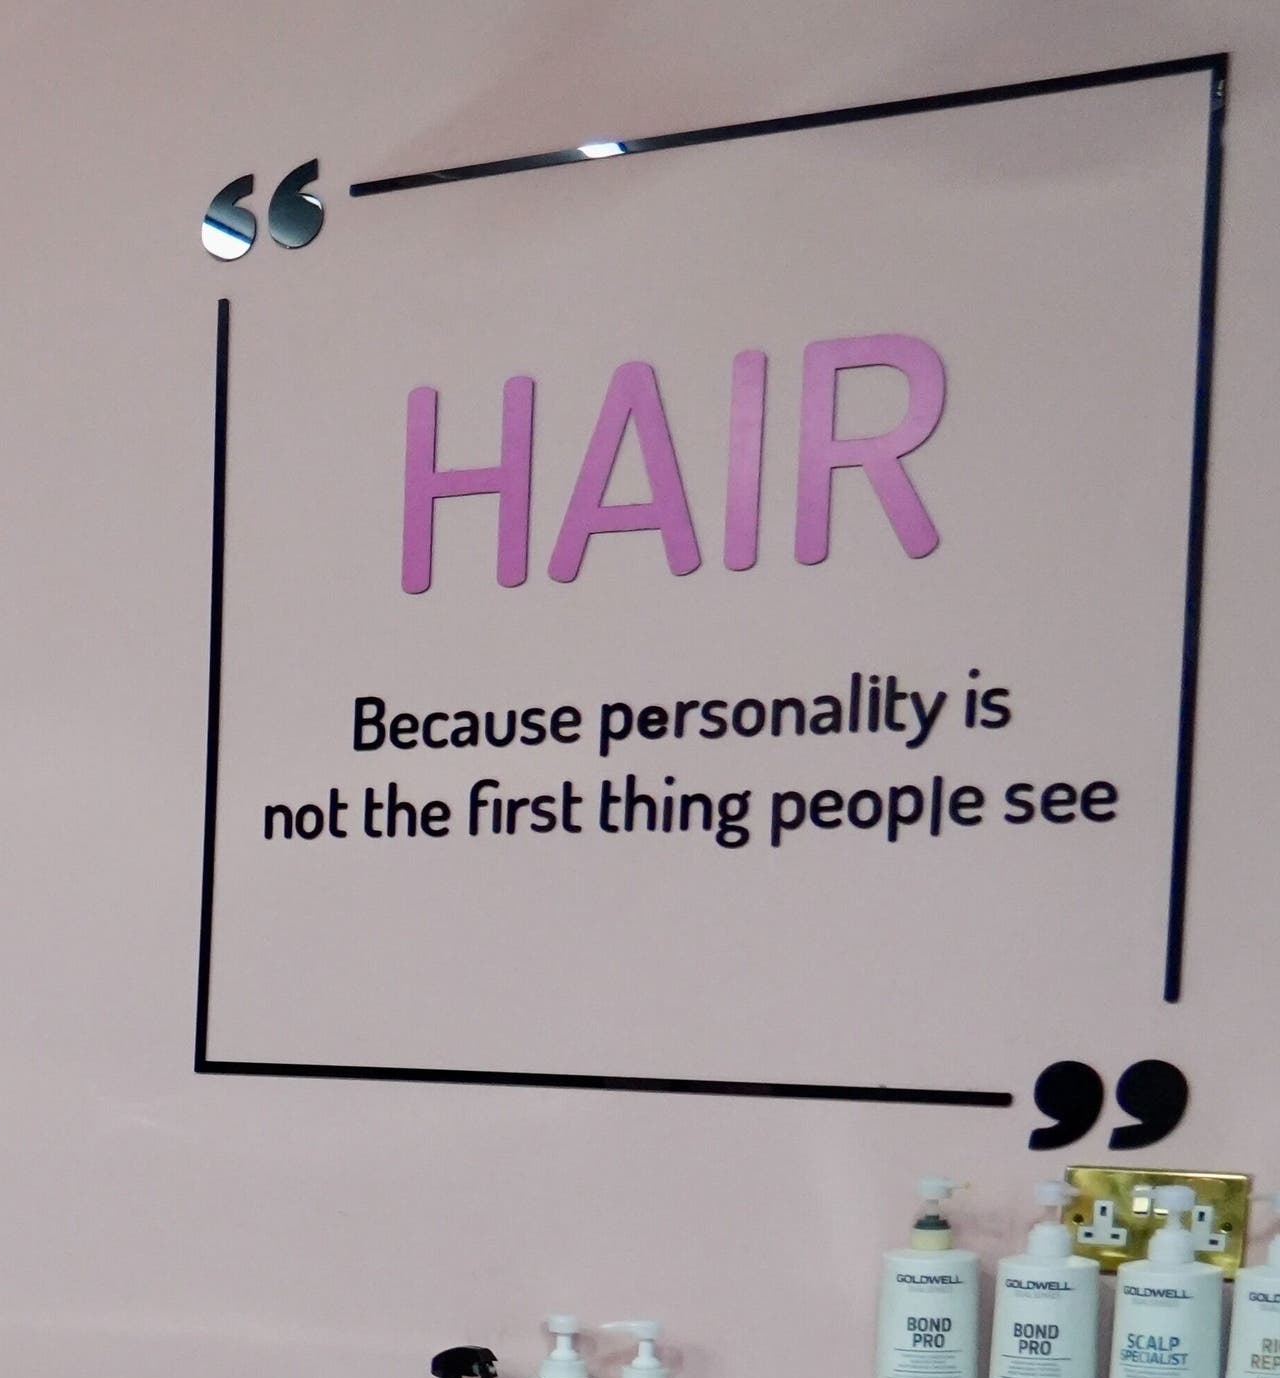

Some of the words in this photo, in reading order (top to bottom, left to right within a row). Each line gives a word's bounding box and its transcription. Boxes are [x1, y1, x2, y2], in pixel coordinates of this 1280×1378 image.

[400, 333, 947, 595] HAIR
[352, 695, 583, 752] Because
[598, 672, 948, 757] personality
[963, 668, 1012, 729] is
[262, 786, 349, 840] not
[363, 780, 451, 840] the
[468, 776, 583, 837] first
[598, 774, 751, 848] thing
[769, 774, 985, 847] people
[1003, 777, 1119, 824] see
[896, 1273, 964, 1285] GOLDWELL
[1004, 1278, 1075, 1291] GOLDWELL
[1122, 1285, 1194, 1300] GOLDWELL
[1248, 1291, 1280, 1303] GOLD
[907, 1316, 952, 1332] BOND
[1013, 1322, 1060, 1339] BOND
[912, 1333, 946, 1349] PRO
[1018, 1340, 1052, 1356] PRO
[1127, 1333, 1181, 1352] SCALP
[1261, 1337, 1280, 1354] RI
[1120, 1349, 1189, 1366] SPECIALIST
[1250, 1353, 1280, 1371] REP
